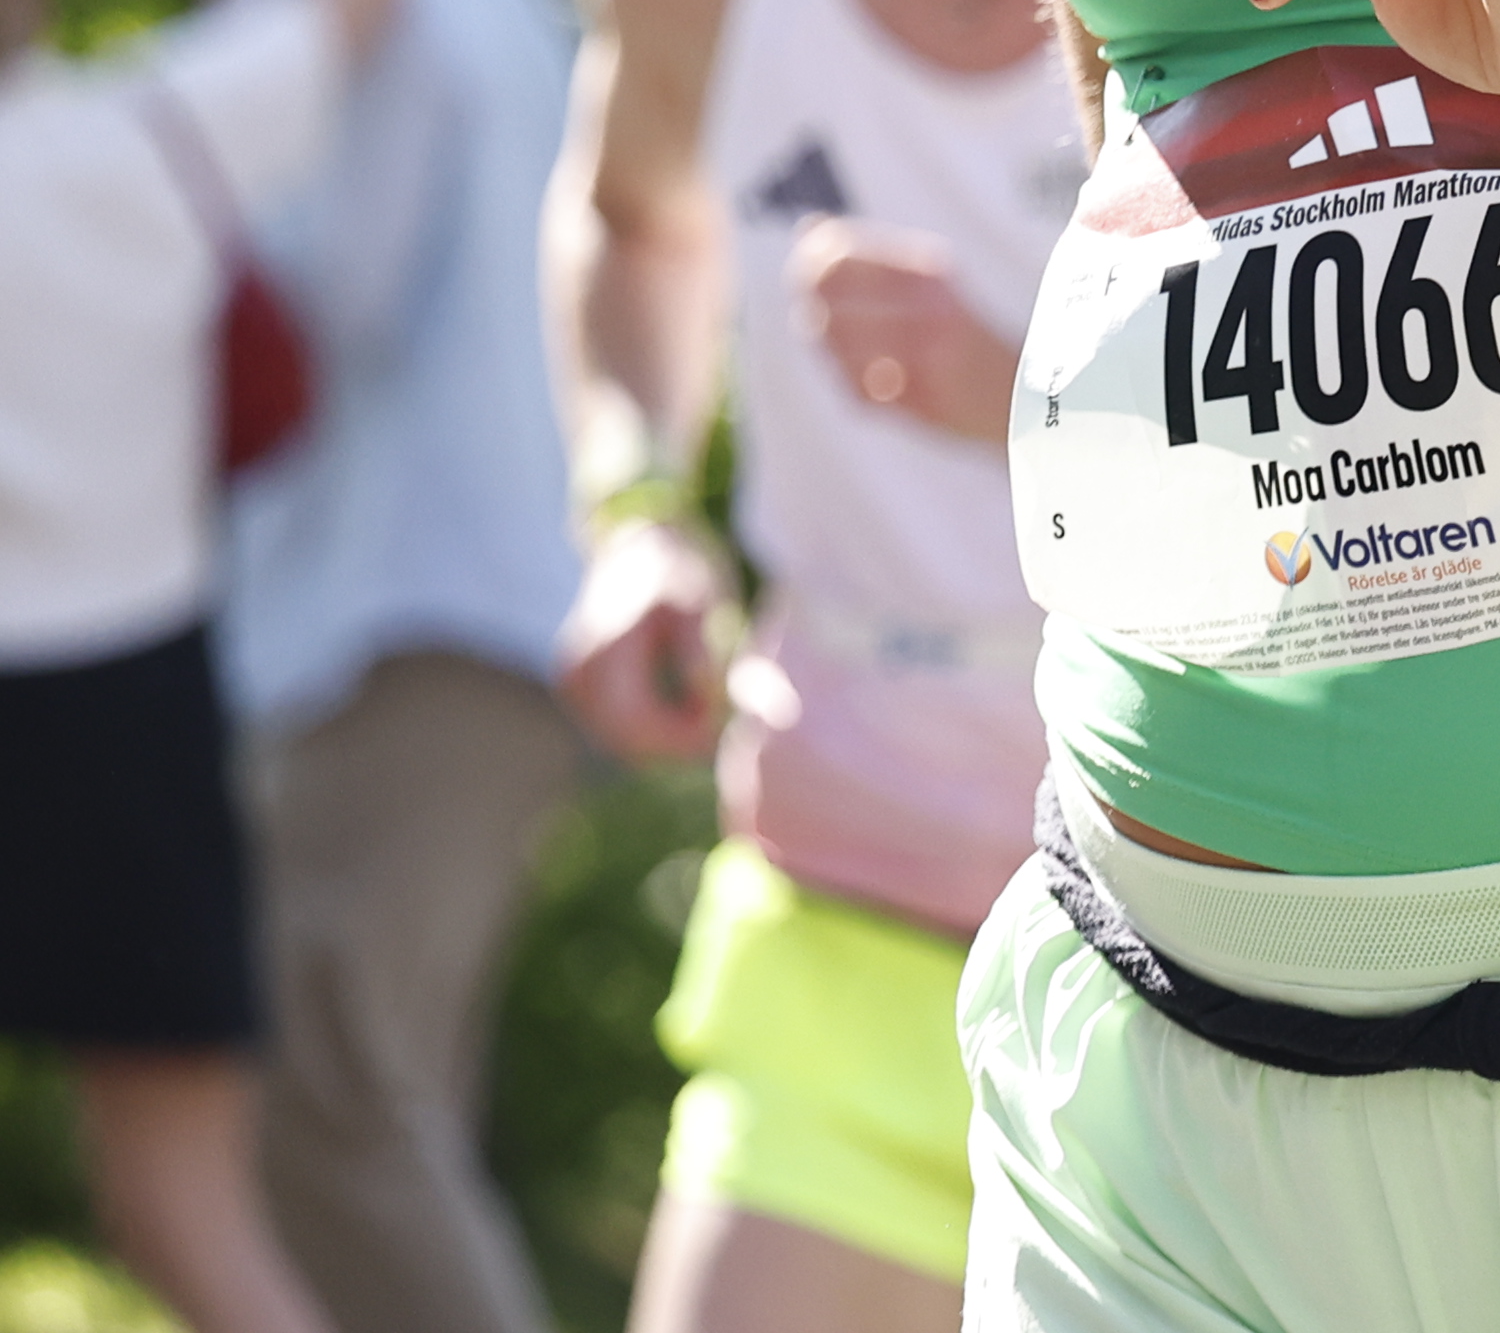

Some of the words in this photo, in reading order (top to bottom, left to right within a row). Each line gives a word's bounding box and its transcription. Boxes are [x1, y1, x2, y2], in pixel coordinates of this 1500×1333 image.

[1211, 215, 1263, 242] didas
[1271, 188, 1385, 232] Stockholm
[1251, 461, 1327, 509] Moa
[1330, 438, 1486, 498] Carblom
[1053, 513, 1065, 539] S
[1311, 516, 1496, 571] Voltaren
[1347, 570, 1408, 592] Rörelse
[1412, 566, 1427, 581] är
[1432, 557, 1482, 581] glädje
